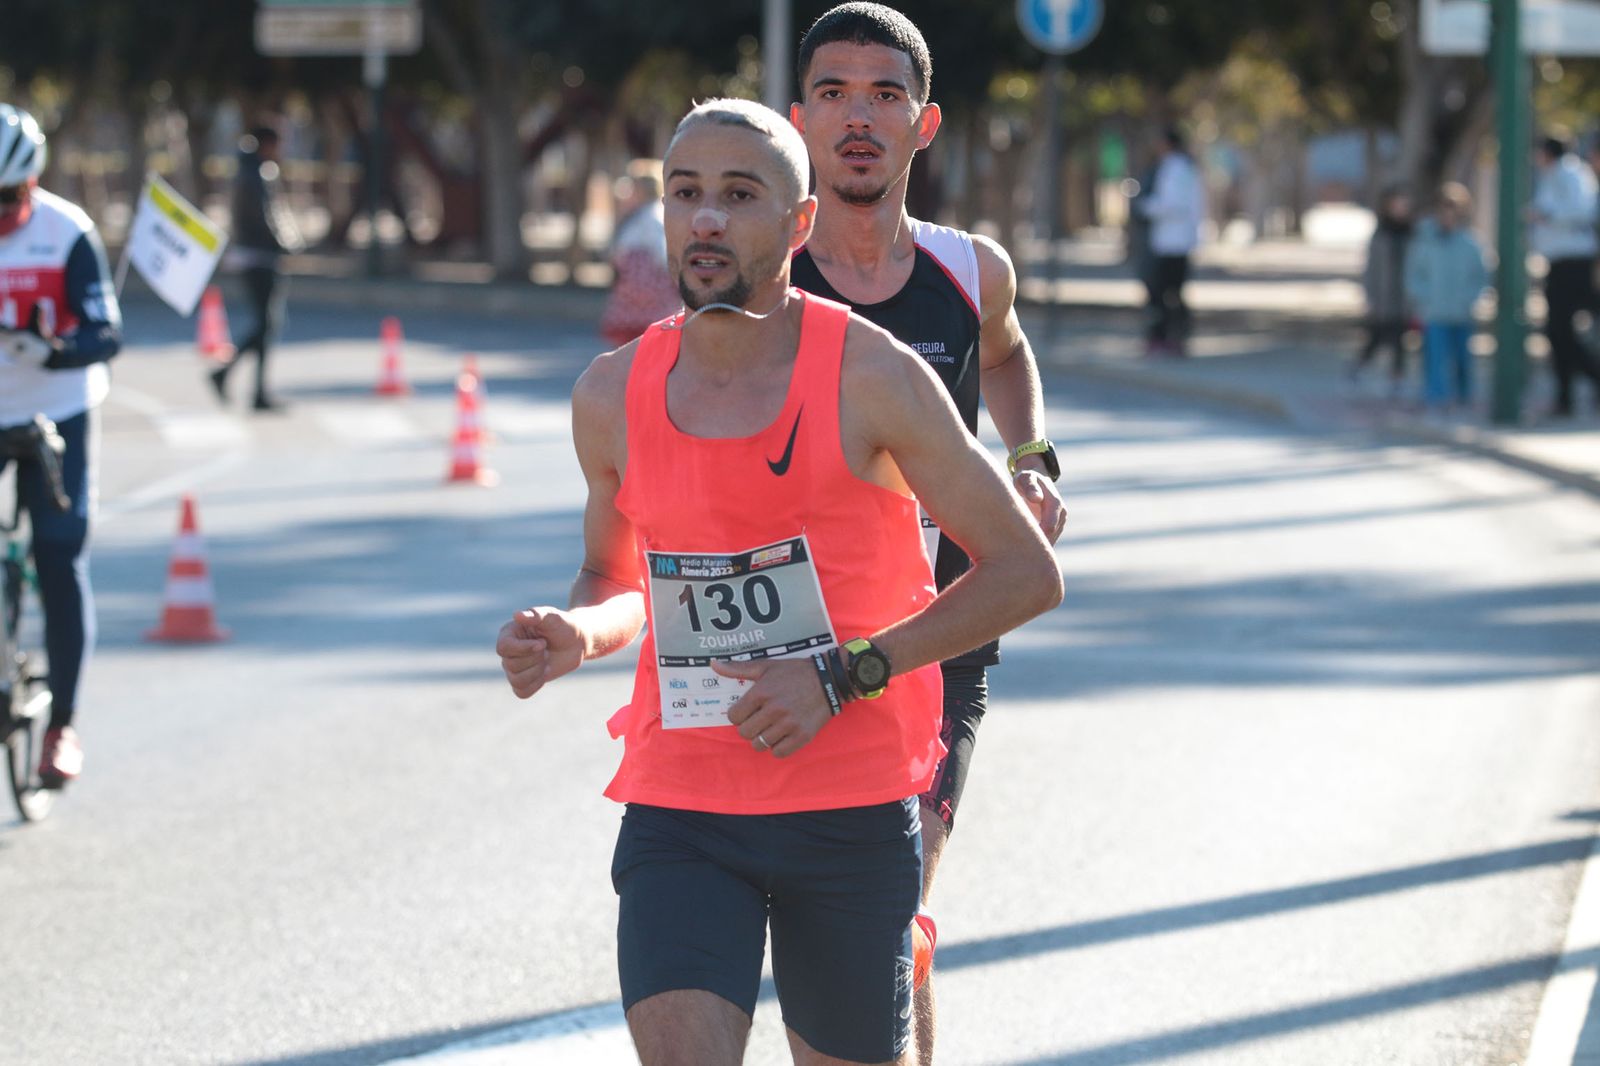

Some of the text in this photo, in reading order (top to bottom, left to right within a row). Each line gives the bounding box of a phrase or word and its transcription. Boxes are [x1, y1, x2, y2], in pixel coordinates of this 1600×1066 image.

[911, 342, 945, 354] SEGURA
[680, 558, 701, 567] Medio
[710, 566, 735, 577] 2022
[678, 574, 781, 632] 130
[698, 628, 767, 649] ZOUHAIR
[702, 678, 720, 688] CDX
